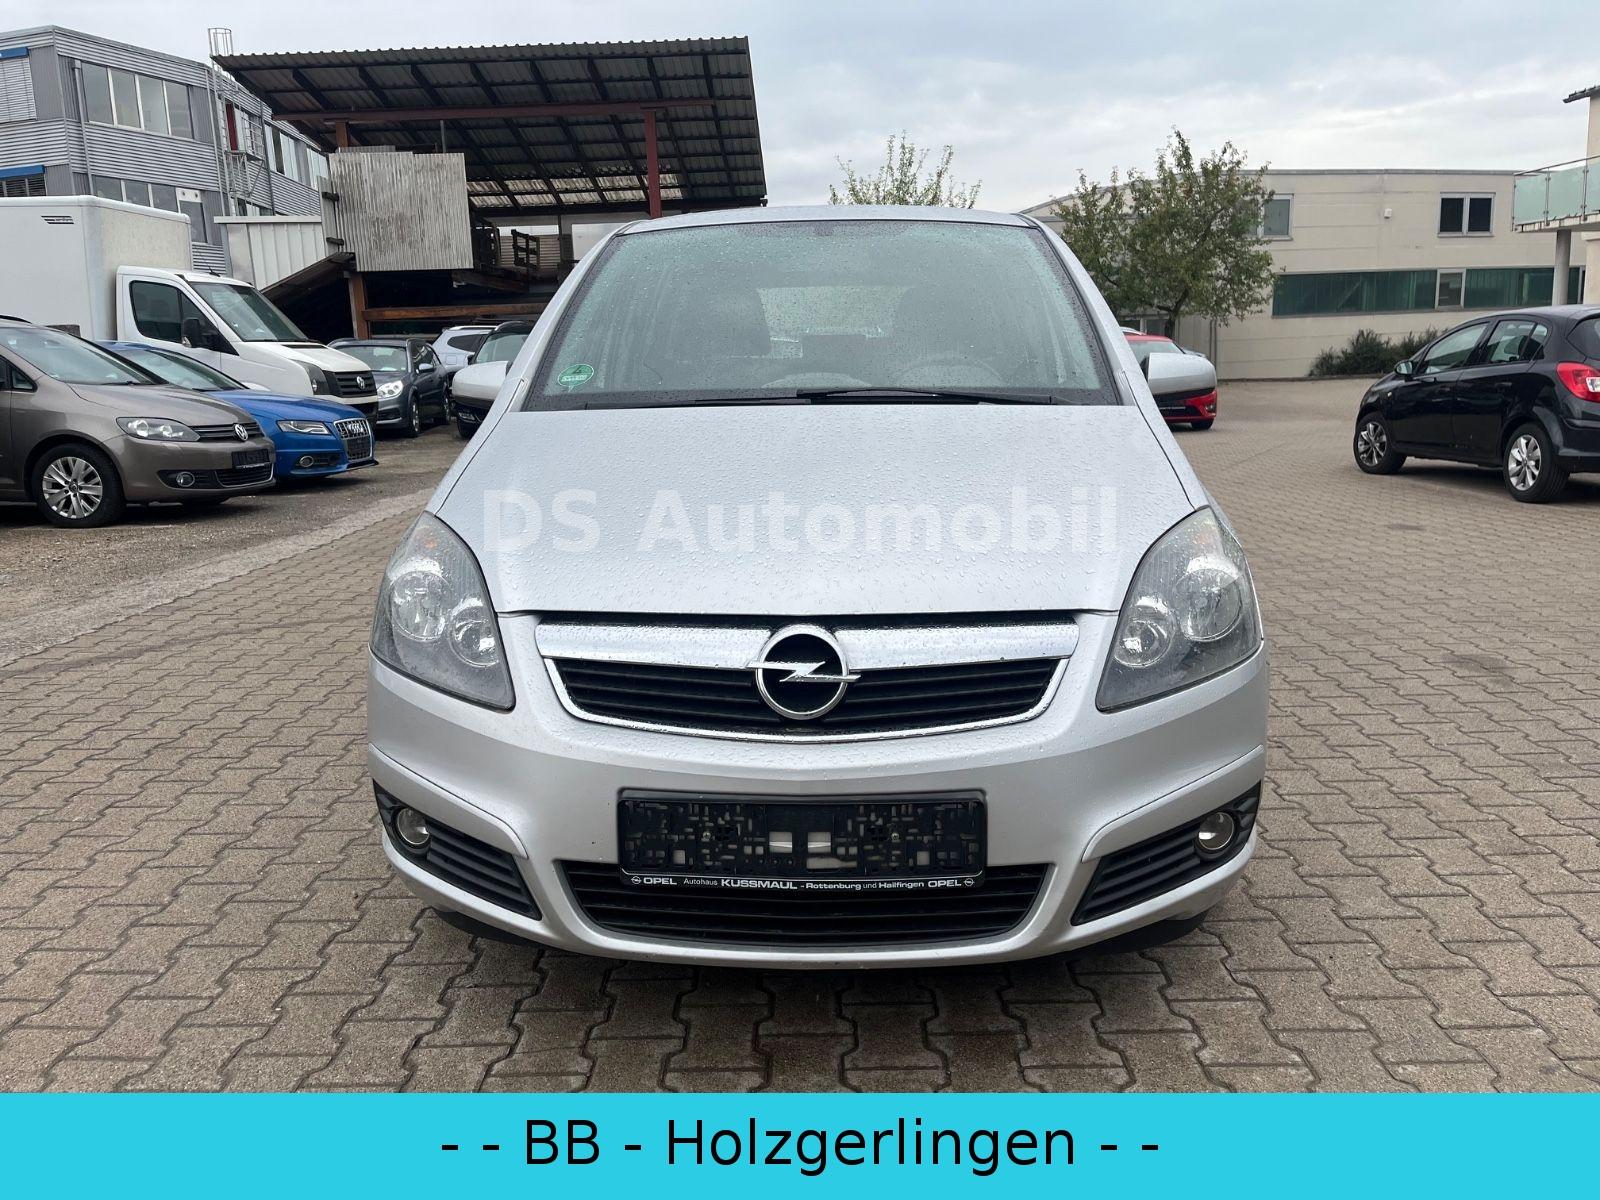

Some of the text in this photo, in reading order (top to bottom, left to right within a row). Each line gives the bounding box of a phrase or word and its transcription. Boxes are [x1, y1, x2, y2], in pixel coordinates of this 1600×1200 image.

[643, 877, 677, 885] OPEL
[683, 878, 718, 886] Autohaus
[721, 879, 798, 889] KUSSMAUL
[805, 882, 862, 890] Rottenburg
[928, 879, 962, 888] OPEL
